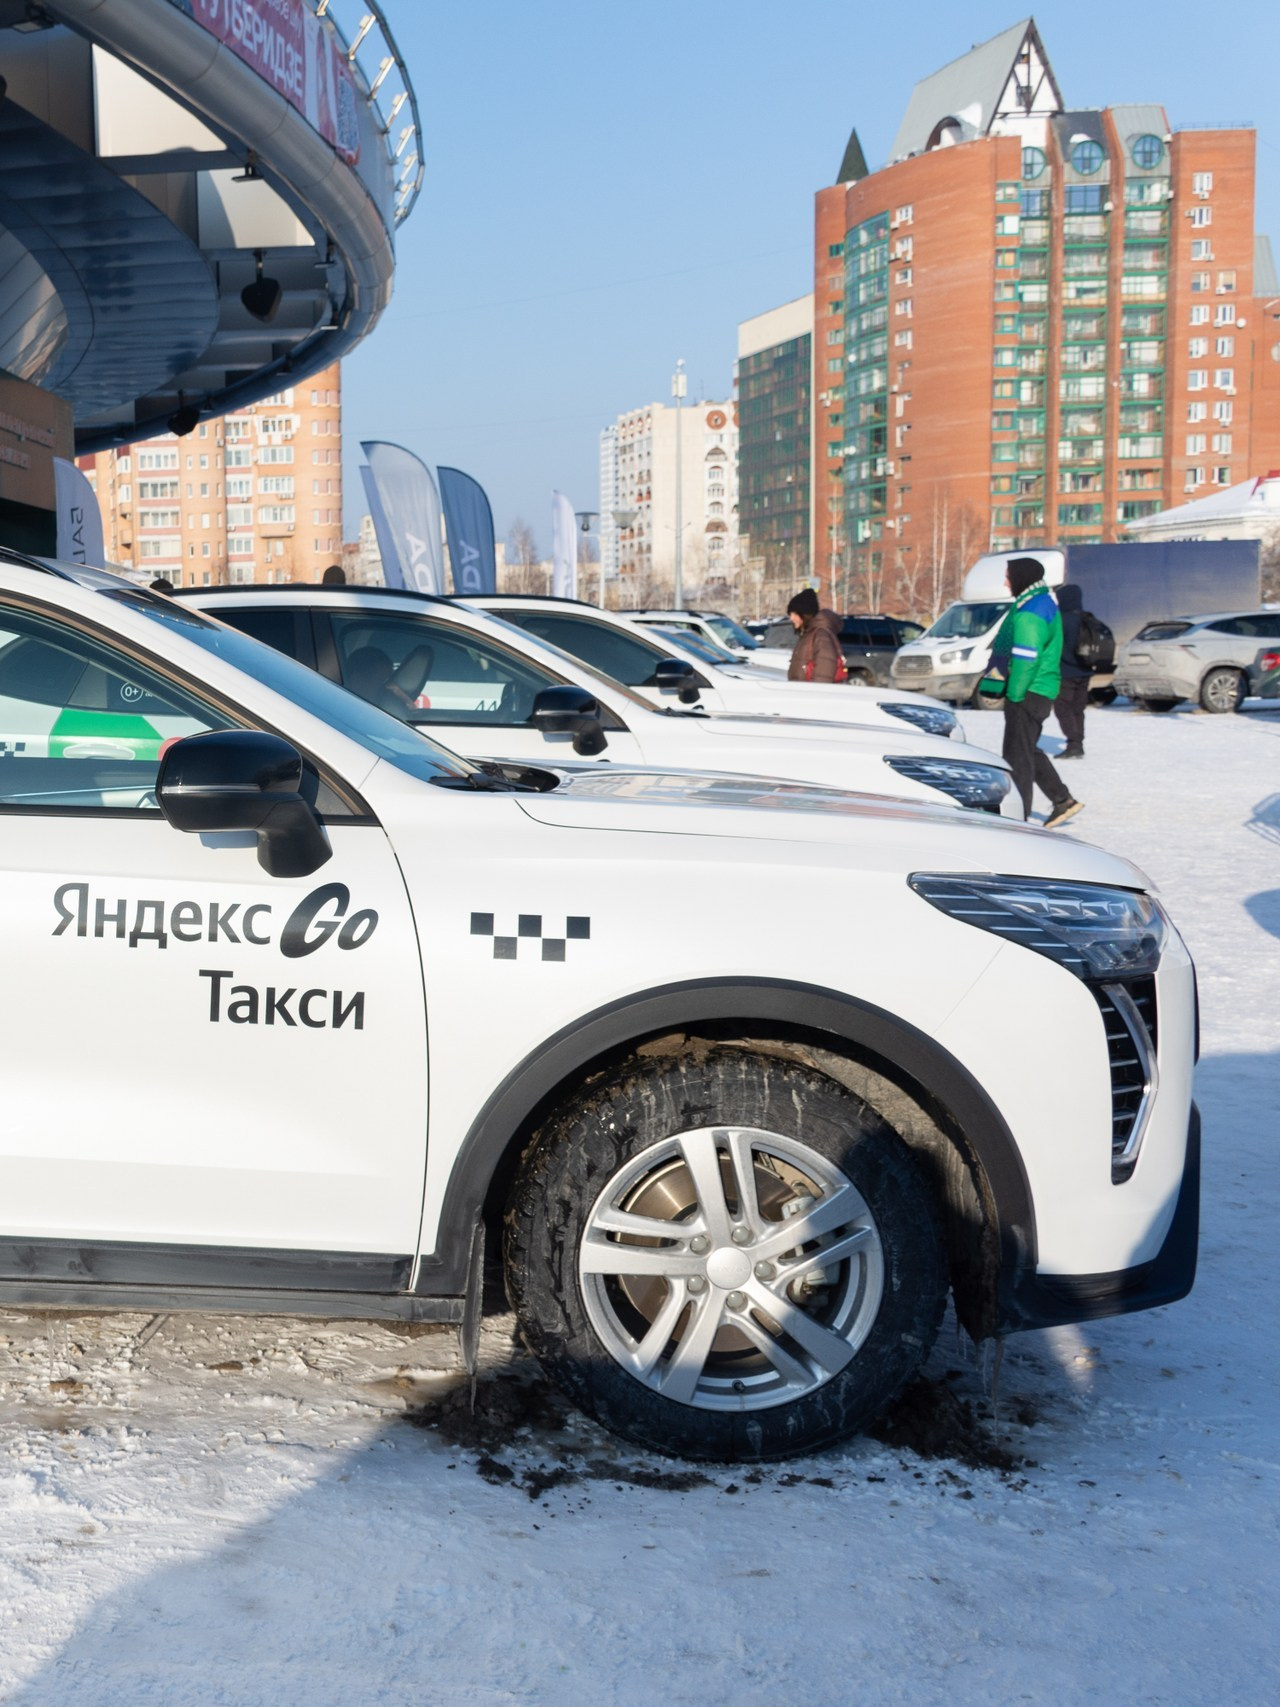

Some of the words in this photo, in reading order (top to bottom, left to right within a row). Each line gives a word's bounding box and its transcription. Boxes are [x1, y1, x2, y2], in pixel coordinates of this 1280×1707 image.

[201, 0, 303, 98] БЕРИДЗЕ
[51, 882, 272, 949] Яндекс
[279, 882, 379, 958] Go
[198, 969, 366, 1030] Такси
